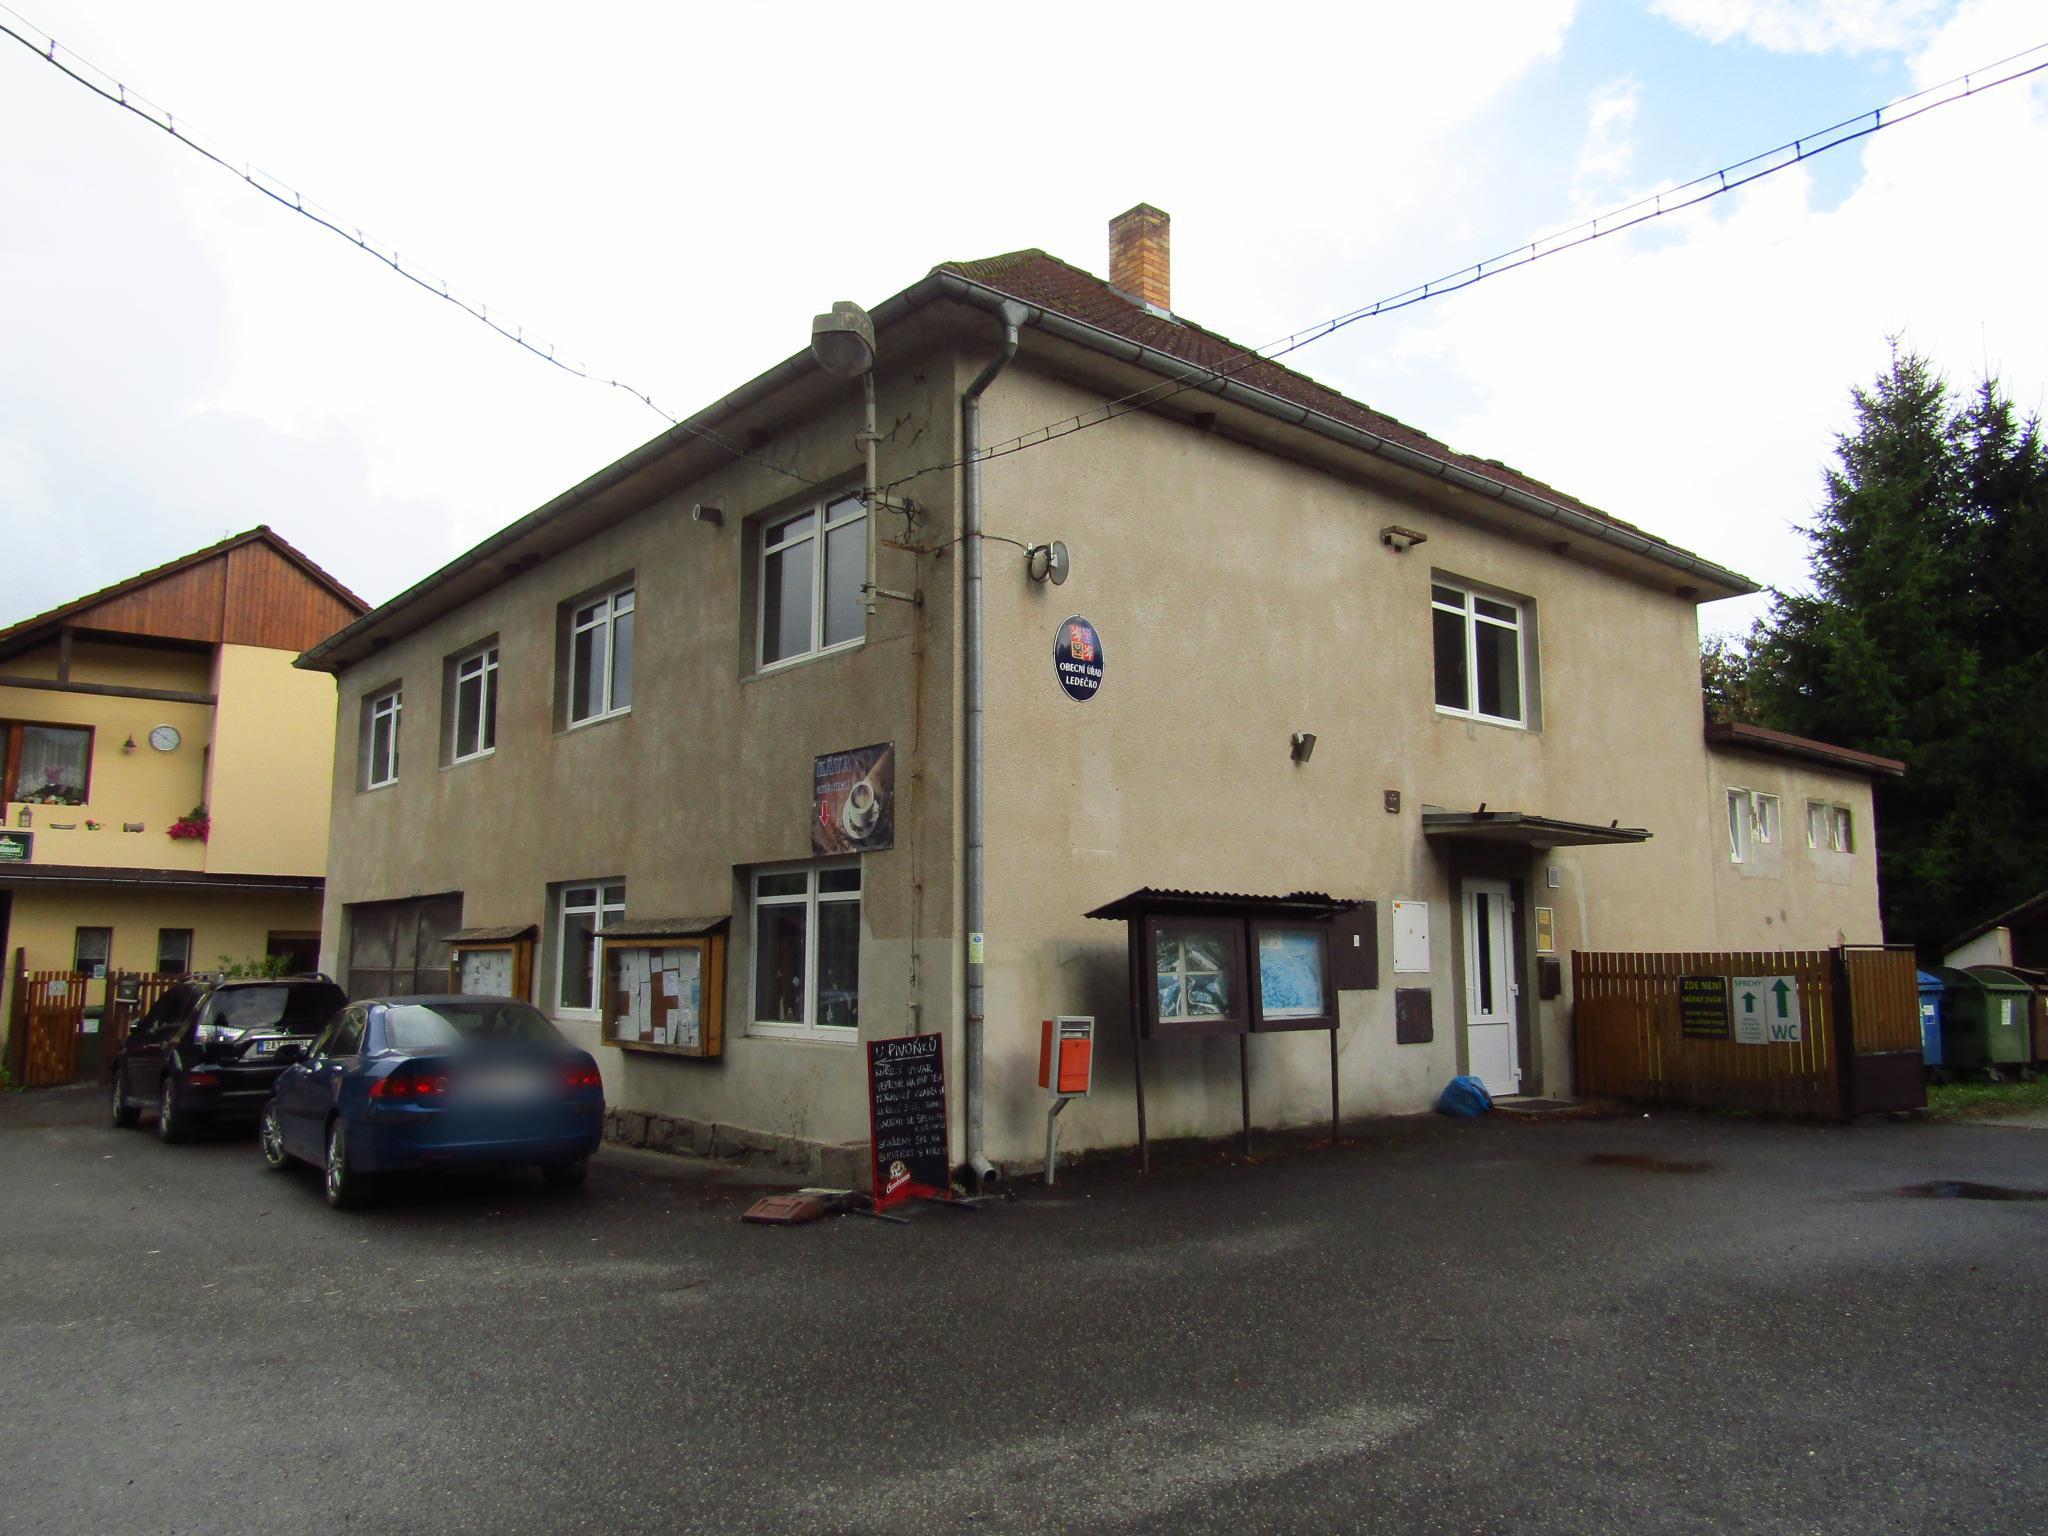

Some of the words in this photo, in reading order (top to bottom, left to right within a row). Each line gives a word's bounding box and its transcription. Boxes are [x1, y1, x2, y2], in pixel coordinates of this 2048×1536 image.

[1060, 662, 1086, 674] OBECNÍ
[1086, 664, 1102, 678] ÚŘAD
[1065, 676, 1098, 689] LEDEČKO
[1684, 981, 1699, 990] ZDE
[1701, 980, 1722, 990] NENÍ
[1771, 1024, 1798, 1040] WC
[888, 1036, 937, 1057] PIVOŇKŮ
